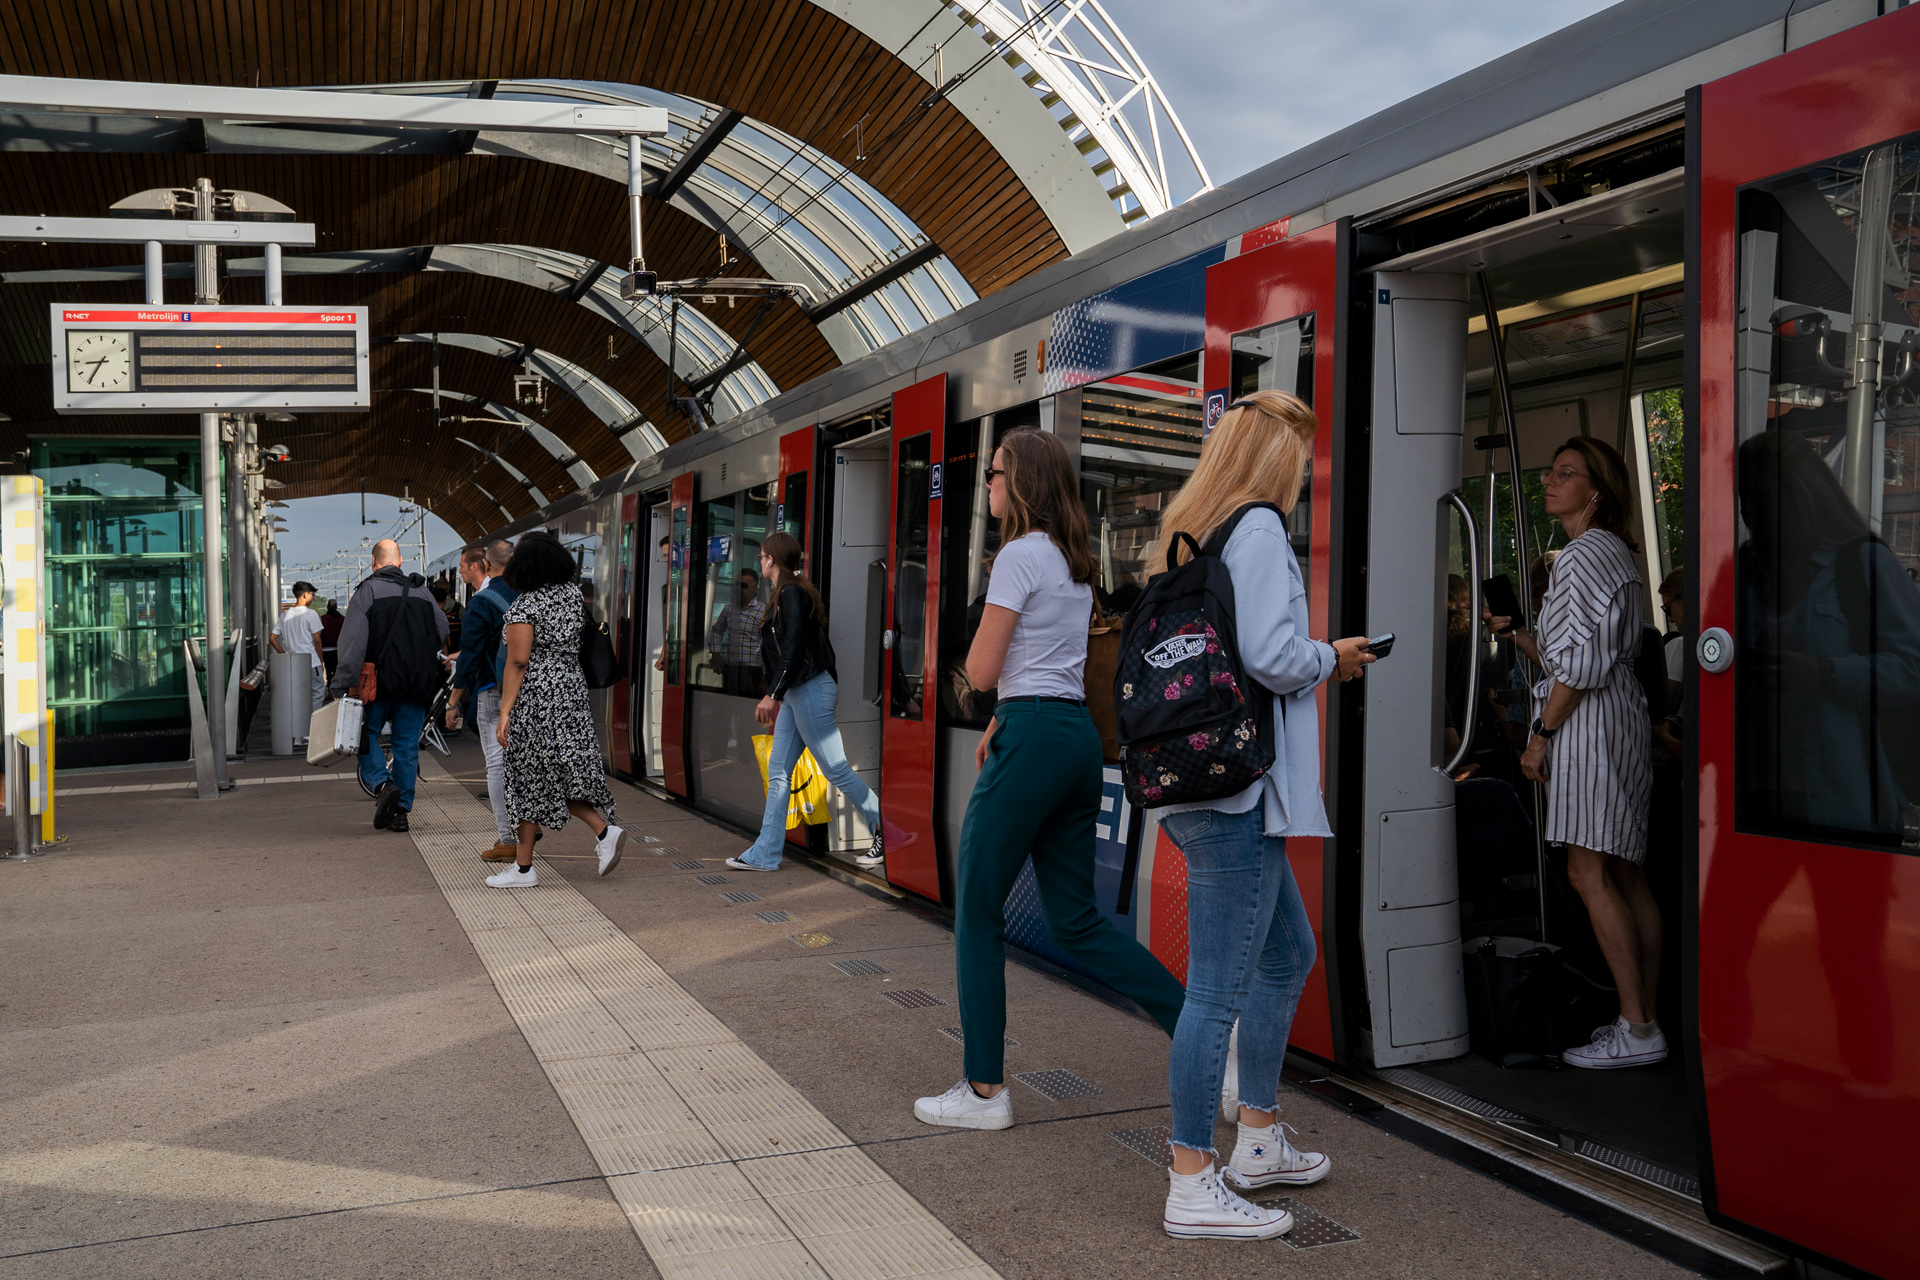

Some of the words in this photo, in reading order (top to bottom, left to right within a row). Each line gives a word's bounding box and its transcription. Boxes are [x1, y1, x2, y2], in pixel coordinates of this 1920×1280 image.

[138, 312, 179, 322] Metrolijn
[183, 313, 189, 321] E
[321, 314, 345, 323] Spoor
[1163, 639, 1187, 653] VANS
[1170, 646, 1185, 659] THE
